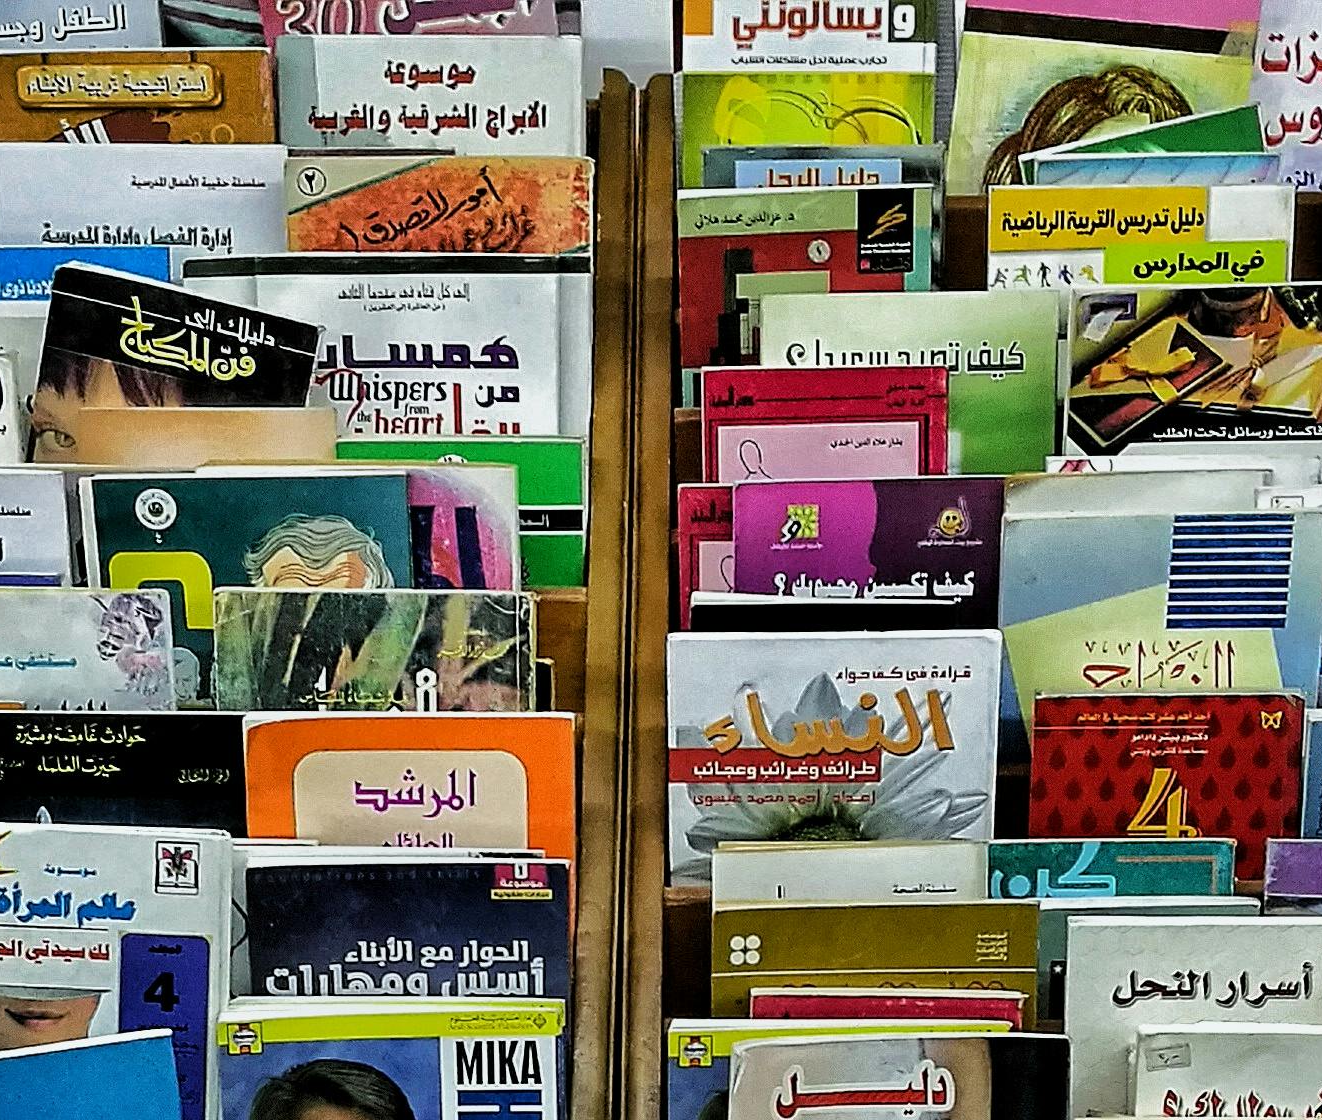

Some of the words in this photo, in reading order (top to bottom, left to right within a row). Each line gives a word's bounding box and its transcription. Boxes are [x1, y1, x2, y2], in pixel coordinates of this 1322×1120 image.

[383, 60, 476, 88] موسوعة
[1133, 252, 1228, 278] المدارس
[1230, 248, 1265, 278] في
[329, 375, 447, 405] Whispers
[375, 410, 444, 437] heart
[705, 690, 955, 756] النساء
[354, 770, 477, 818] المرشد
[418, 946, 457, 968] مع
[462, 941, 529, 965] الحوار
[144, 972, 179, 1013] 4
[457, 1040, 541, 1086] MIKA
